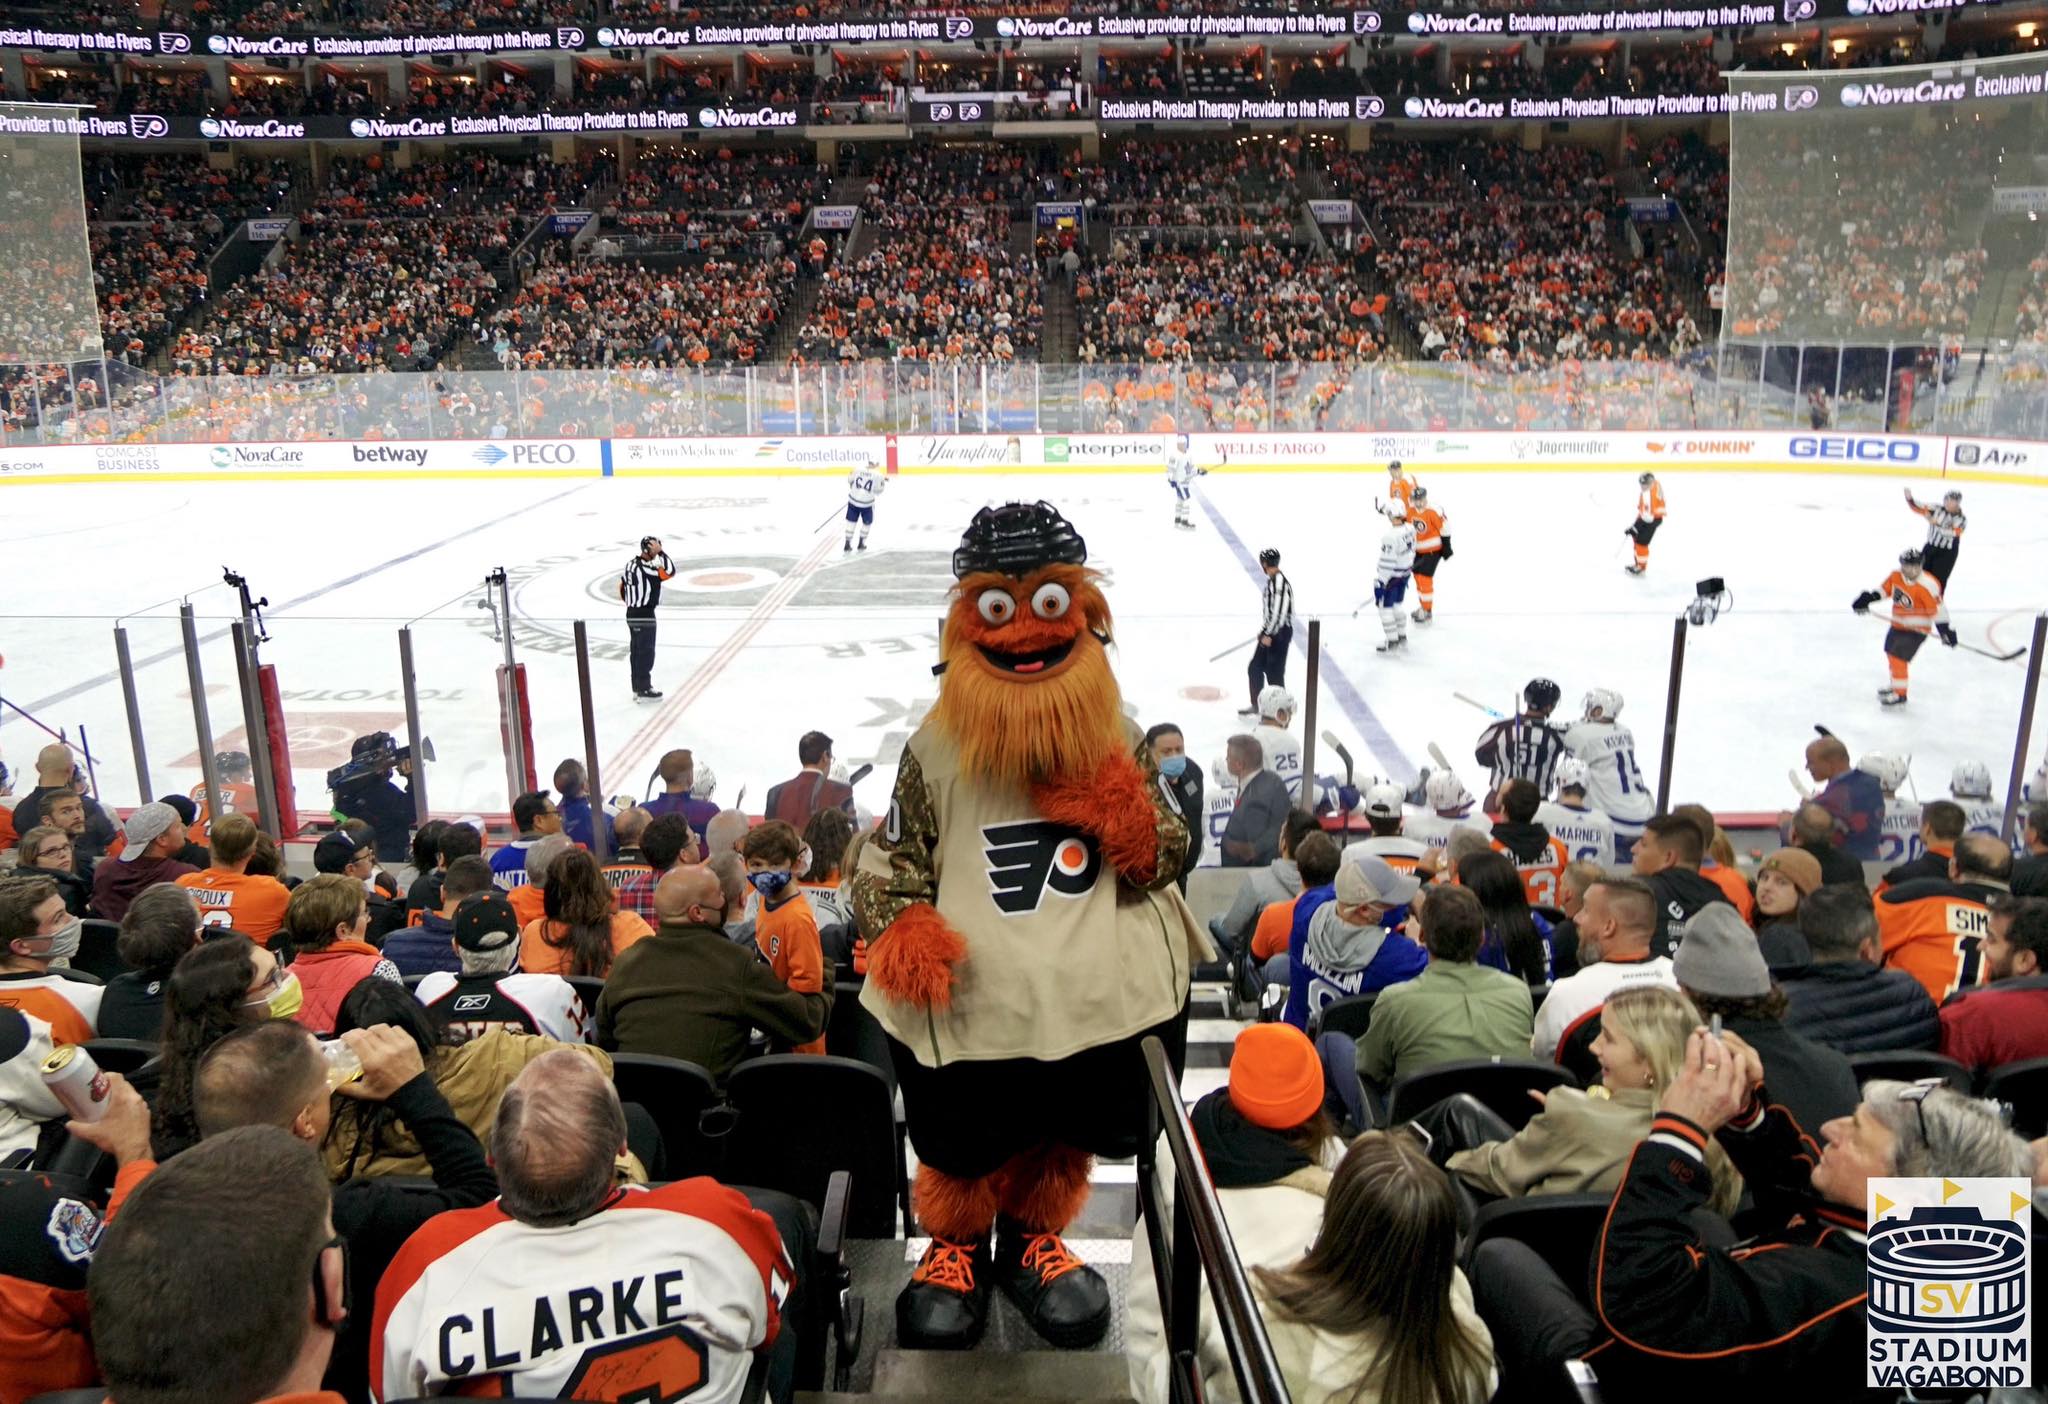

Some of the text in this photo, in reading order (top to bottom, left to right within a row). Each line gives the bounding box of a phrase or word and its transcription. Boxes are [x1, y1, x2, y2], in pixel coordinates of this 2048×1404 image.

[1013, 17, 1092, 36] NovaCare
[1099, 13, 1346, 35] Exclusive provider of physical therapy to the Flyers
[1424, 13, 1503, 32] NovaCare
[1509, 4, 1775, 32] Exclusive provider of physical therapy to the Flyers
[33, 29, 80, 49] therapy
[81, 33, 94, 48] to
[94, 33, 115, 49] the
[115, 33, 152, 51] Flyers
[614, 27, 690, 46] NovaCare
[696, 20, 939, 43] Exclusive provider of physical therapy to the Flyers
[227, 36, 308, 54] NovaCare
[314, 31, 550, 55] Exclusive provider of physical therapy to the Flyers
[1861, 80, 1966, 106] NovaCare
[1975, 73, 2041, 97] Exclusive
[1102, 98, 1349, 120] Exclusive Physical Therapy Provider to the Flyers
[1422, 98, 1504, 118] NovaCare
[1511, 91, 1777, 118] Exclusive Physical Therapy Provider to the Flyers
[0, 114, 128, 136] Provider to the Flyers
[451, 110, 688, 134] Exclusive Physical Therapy Provider to the Flyers
[716, 107, 796, 127] NovaCare
[220, 119, 304, 138] NovaCare
[369, 118, 446, 137] NovaCare
[95, 446, 158, 459] COMCAST
[234, 446, 304, 462] NovaCare
[352, 444, 428, 466] betway
[513, 444, 575, 464] PECO
[786, 449, 870, 462] Constellation
[918, 436, 1008, 464] Yuengling
[1214, 442, 1326, 455] WELLS FARGO
[1373, 448, 1415, 457] MATCH
[1686, 441, 1755, 454] DUNKIN'
[1789, 437, 1920, 462] GEICO
[97, 459, 160, 470] BUSINESS
[1275, 753, 1298, 771] 25
[1555, 825, 1602, 843] MARNER
[771, 937, 780, 954] C
[439, 1269, 687, 1377] CLARKE
